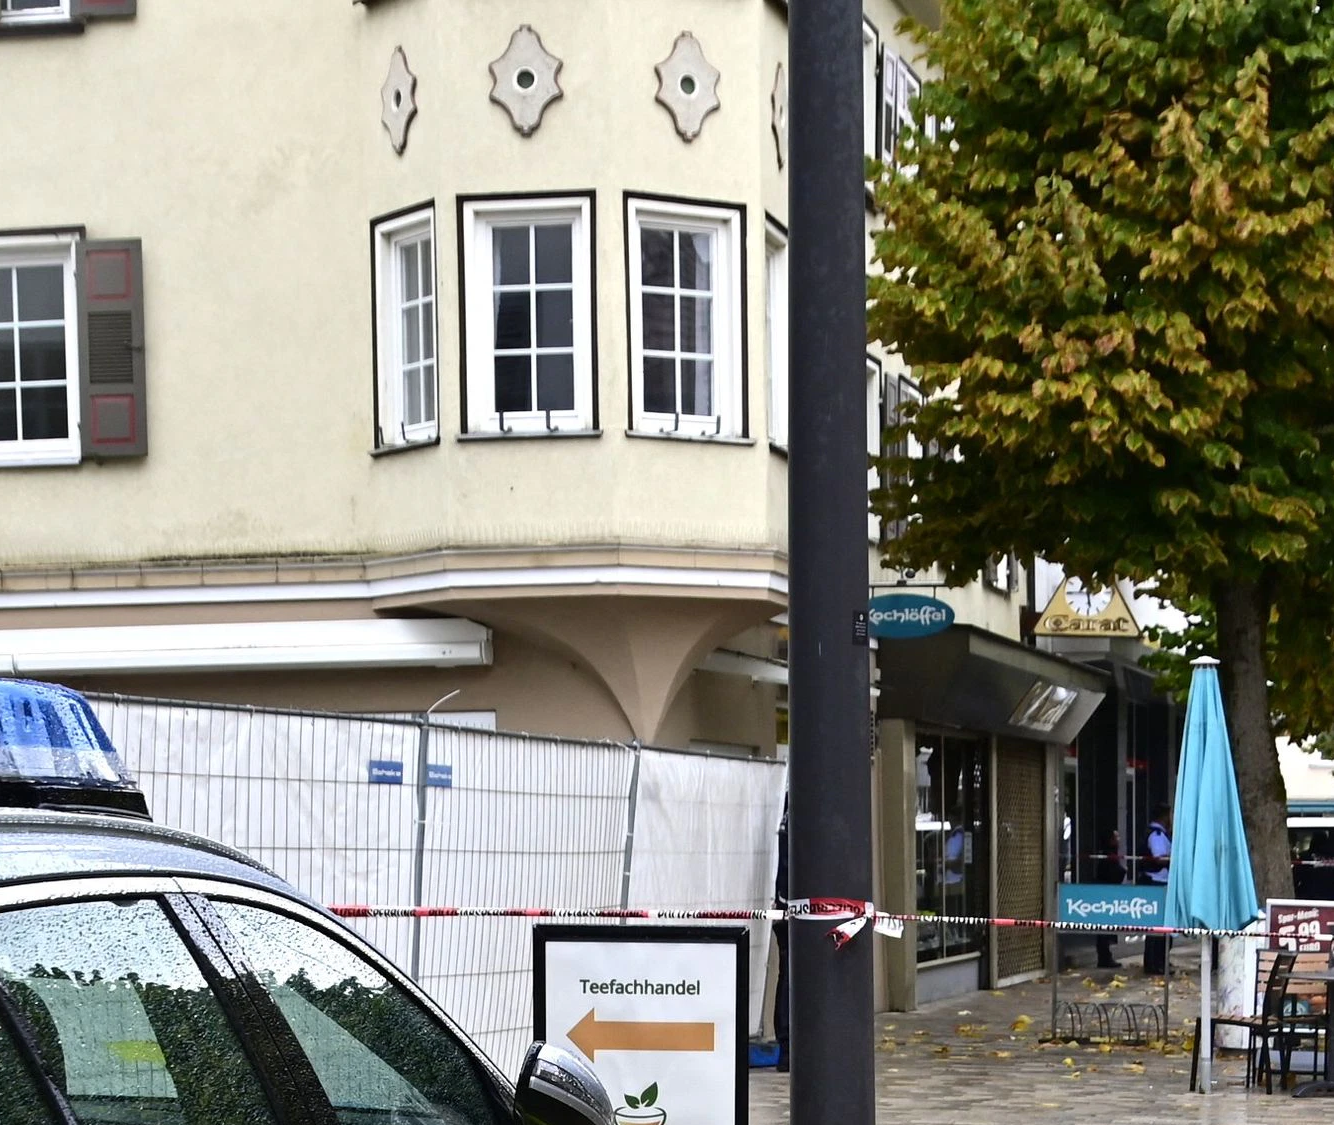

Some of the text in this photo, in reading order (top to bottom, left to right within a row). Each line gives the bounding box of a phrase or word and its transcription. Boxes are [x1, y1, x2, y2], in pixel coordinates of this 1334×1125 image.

[1043, 614, 1129, 632] Carat
[1066, 897, 1158, 919] Kochlöffel
[579, 979, 701, 996] Teefachhandel
